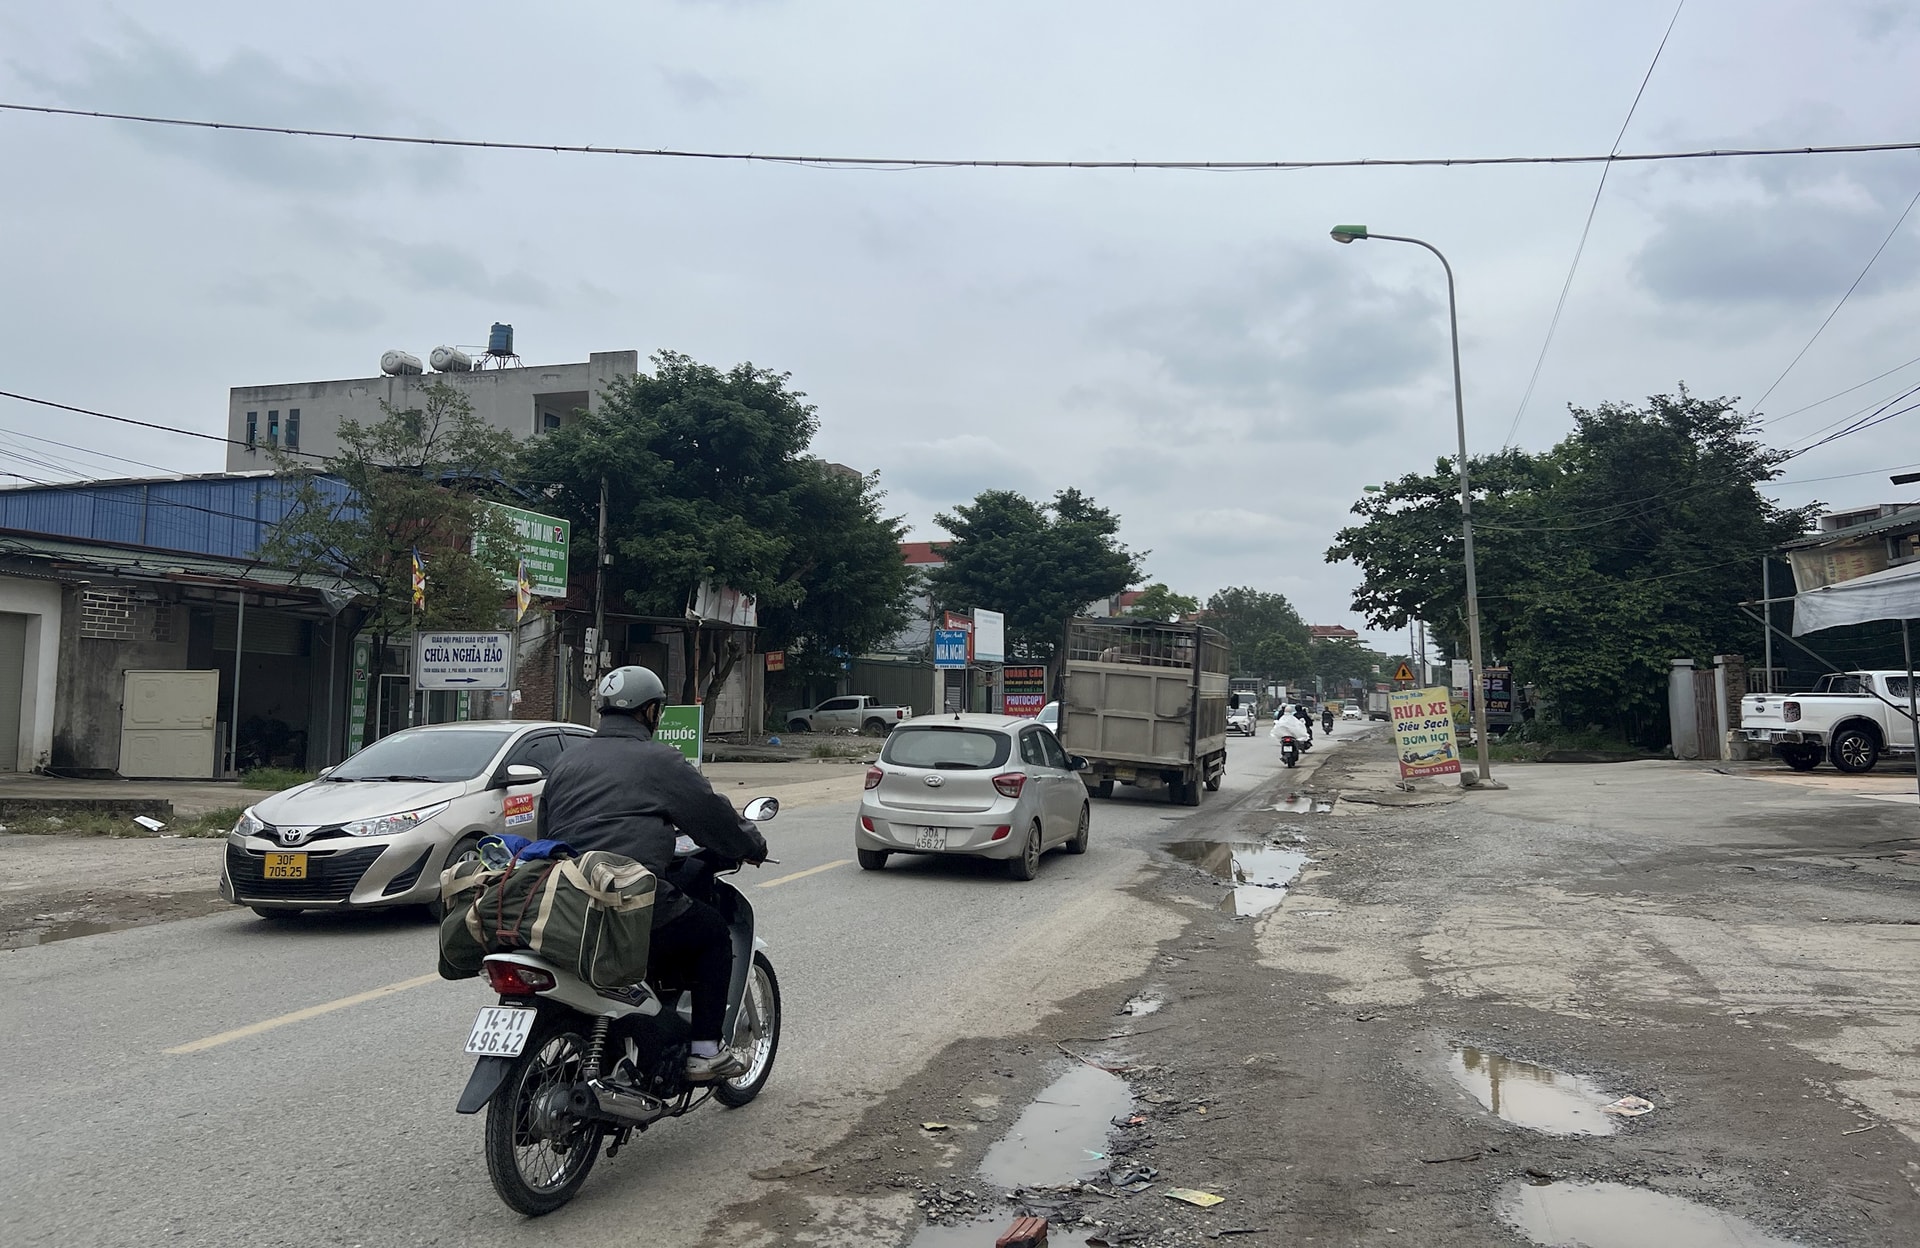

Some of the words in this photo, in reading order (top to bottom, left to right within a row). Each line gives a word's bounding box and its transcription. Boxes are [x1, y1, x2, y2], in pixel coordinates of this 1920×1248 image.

[424, 645, 449, 662] CHÙA
[452, 645, 481, 662] NGHĨA
[483, 643, 503, 662] HẢO
[936, 640, 949, 660] NHÀ
[949, 638, 965, 660] NGHỈ
[1005, 668, 1027, 679] QUẢNG
[1029, 668, 1043, 678] CÁO
[1006, 695, 1043, 705] PHOTOCOPY
[1491, 701, 1509, 710] CAY
[1393, 702, 1424, 719] RỬA
[1428, 702, 1448, 716] XE
[1397, 721, 1420, 732] Siêu
[1424, 718, 1449, 732] Sạch
[658, 725, 696, 740] THUỐC
[1402, 735, 1427, 745] BƠM
[923, 827, 938, 838] 30A
[277, 855, 295, 865] 30F
[269, 866, 302, 877] 705.25
[484, 1009, 526, 1031] 14-X1
[468, 1030, 523, 1053] 496.42
